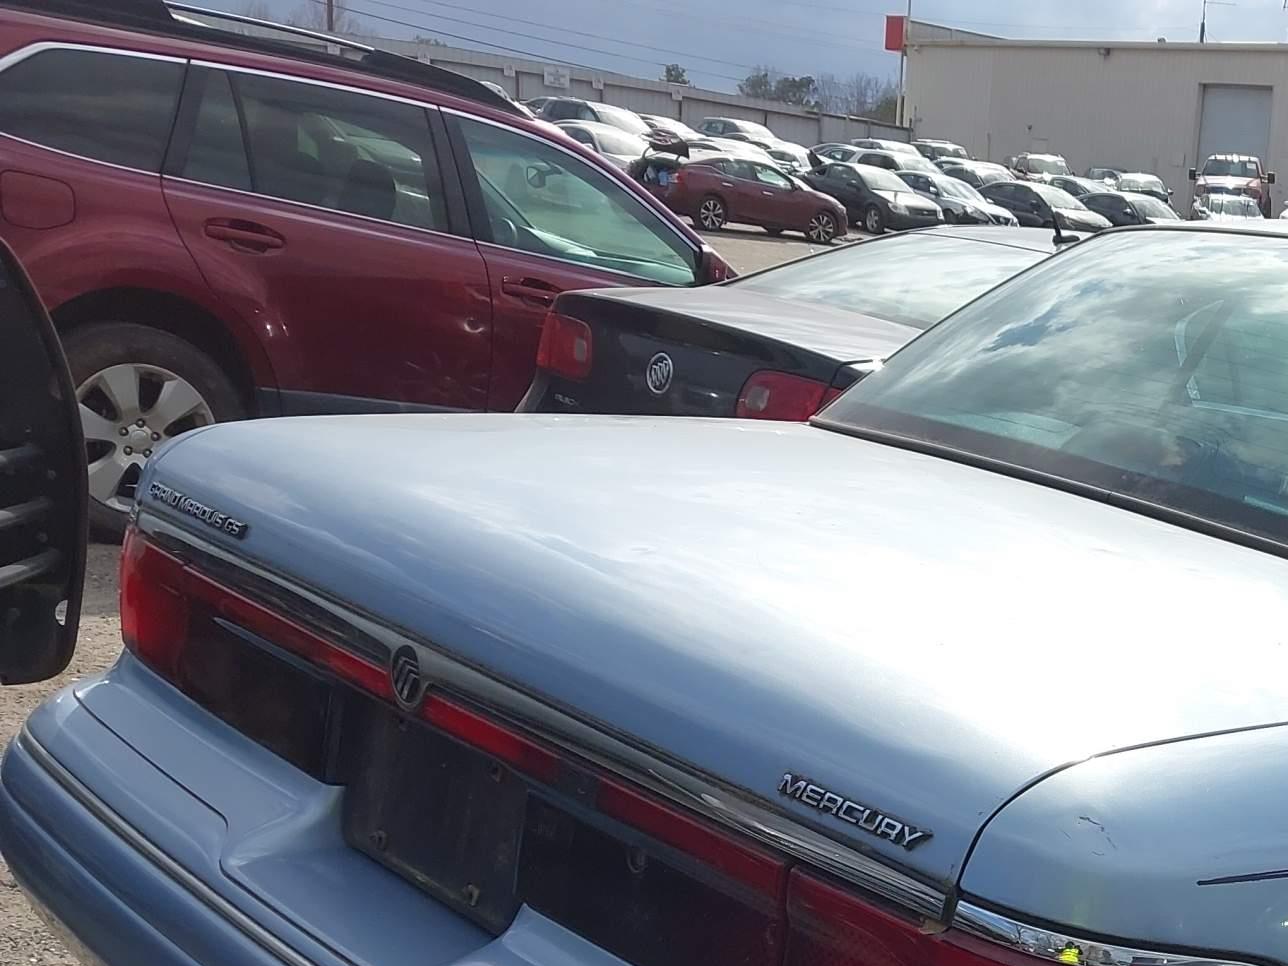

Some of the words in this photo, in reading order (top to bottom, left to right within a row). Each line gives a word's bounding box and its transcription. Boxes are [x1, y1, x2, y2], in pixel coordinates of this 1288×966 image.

[149, 481, 182, 505] GRAND
[179, 496, 227, 527] MARQUIS
[224, 518, 243, 535] GS
[778, 773, 925, 847] MERCURY
